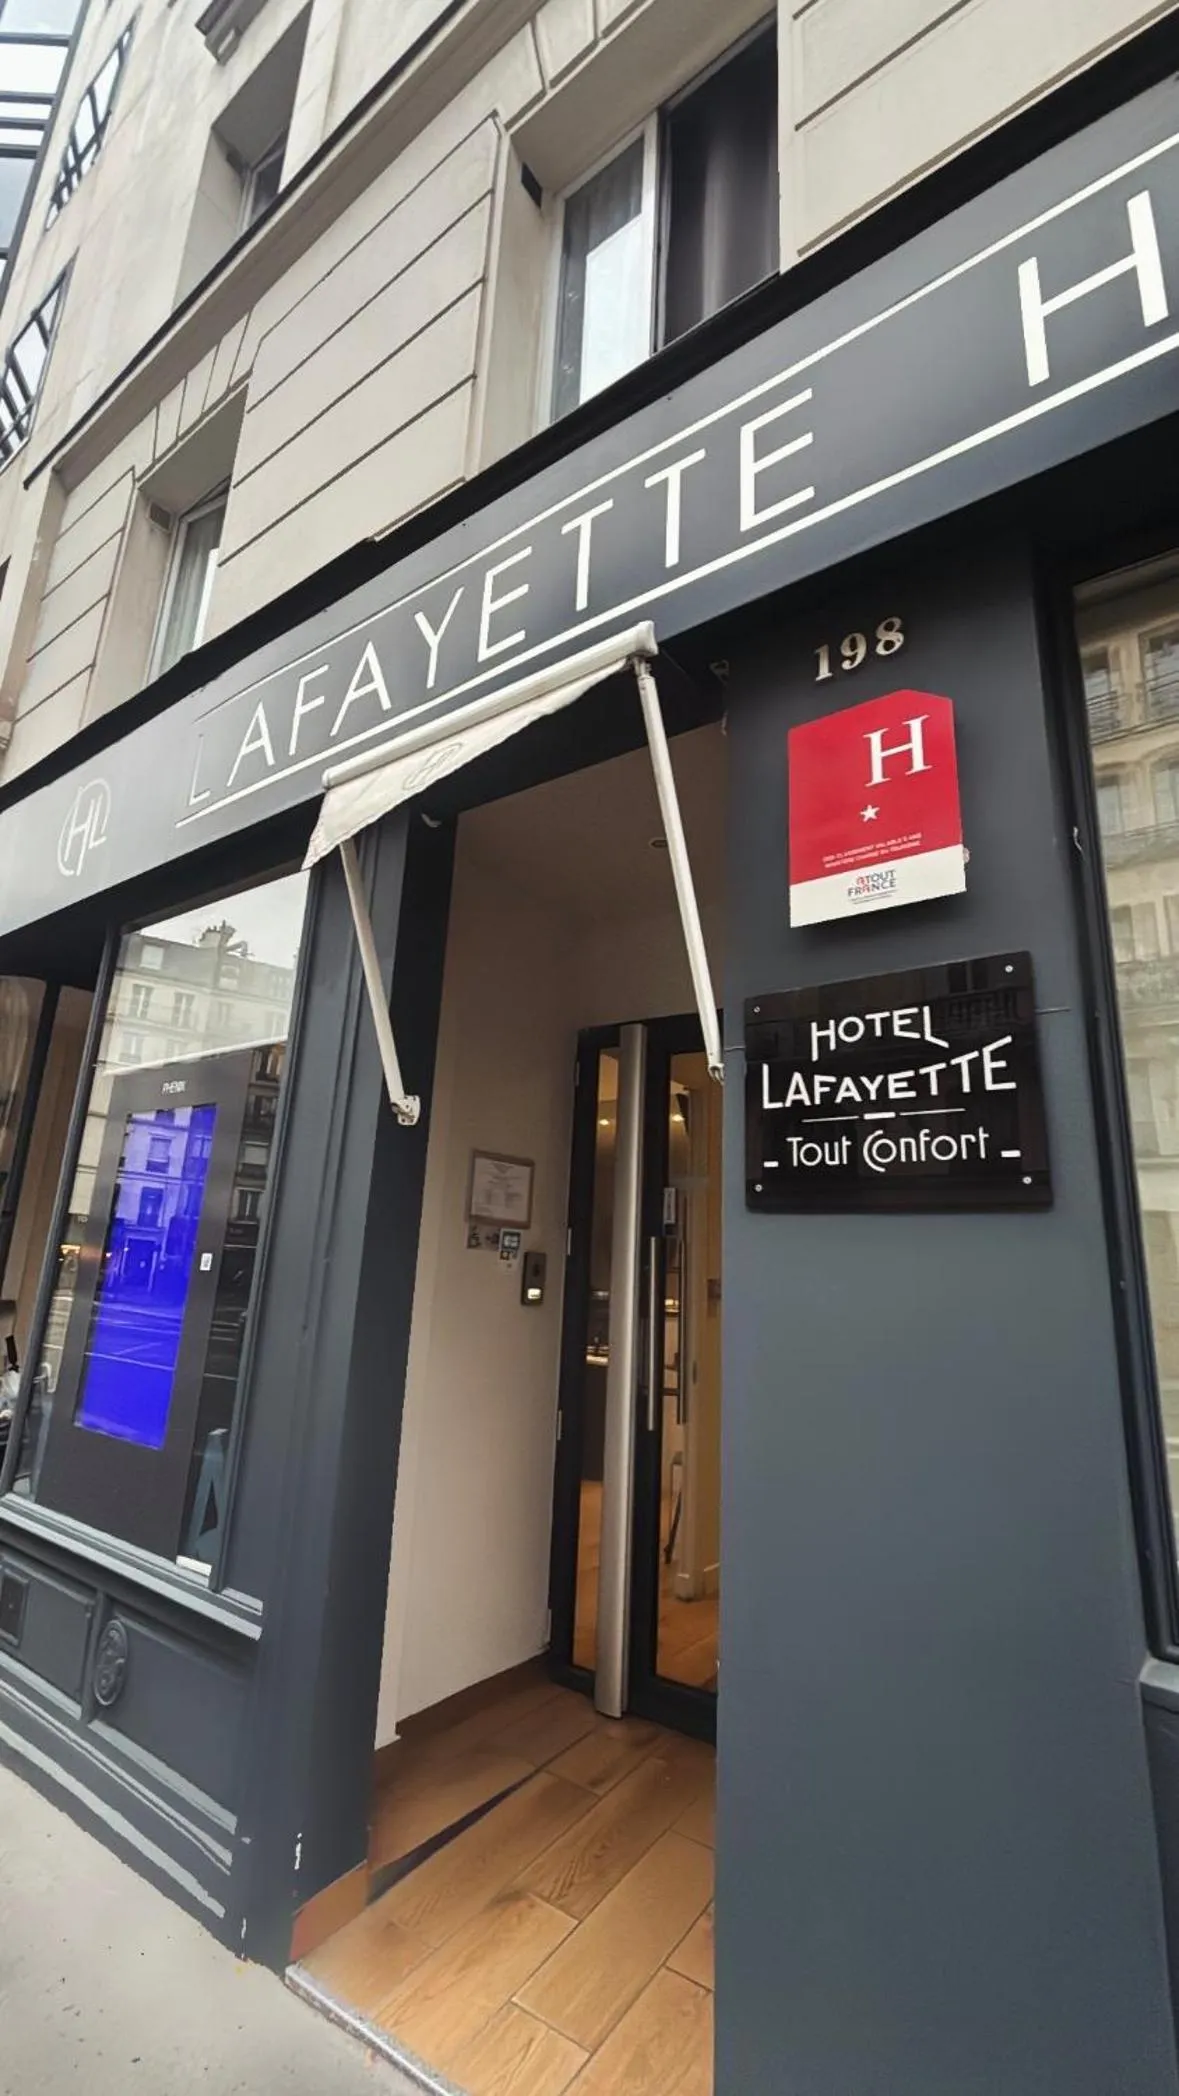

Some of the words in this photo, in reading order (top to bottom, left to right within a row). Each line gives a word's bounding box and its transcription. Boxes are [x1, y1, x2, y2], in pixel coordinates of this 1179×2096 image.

[186, 388, 815, 808] LAFAYETTE
[815, 616, 905, 681] 198
[863, 714, 933, 787] H
[847, 878, 897, 897] FRANCE
[856, 869, 896, 886] ATOUT
[810, 1005, 949, 1062] HOTEL
[762, 1035, 1017, 1110] LAFAYETTE
[786, 1134, 853, 1168] Tout
[862, 1126, 990, 1173] Confort
